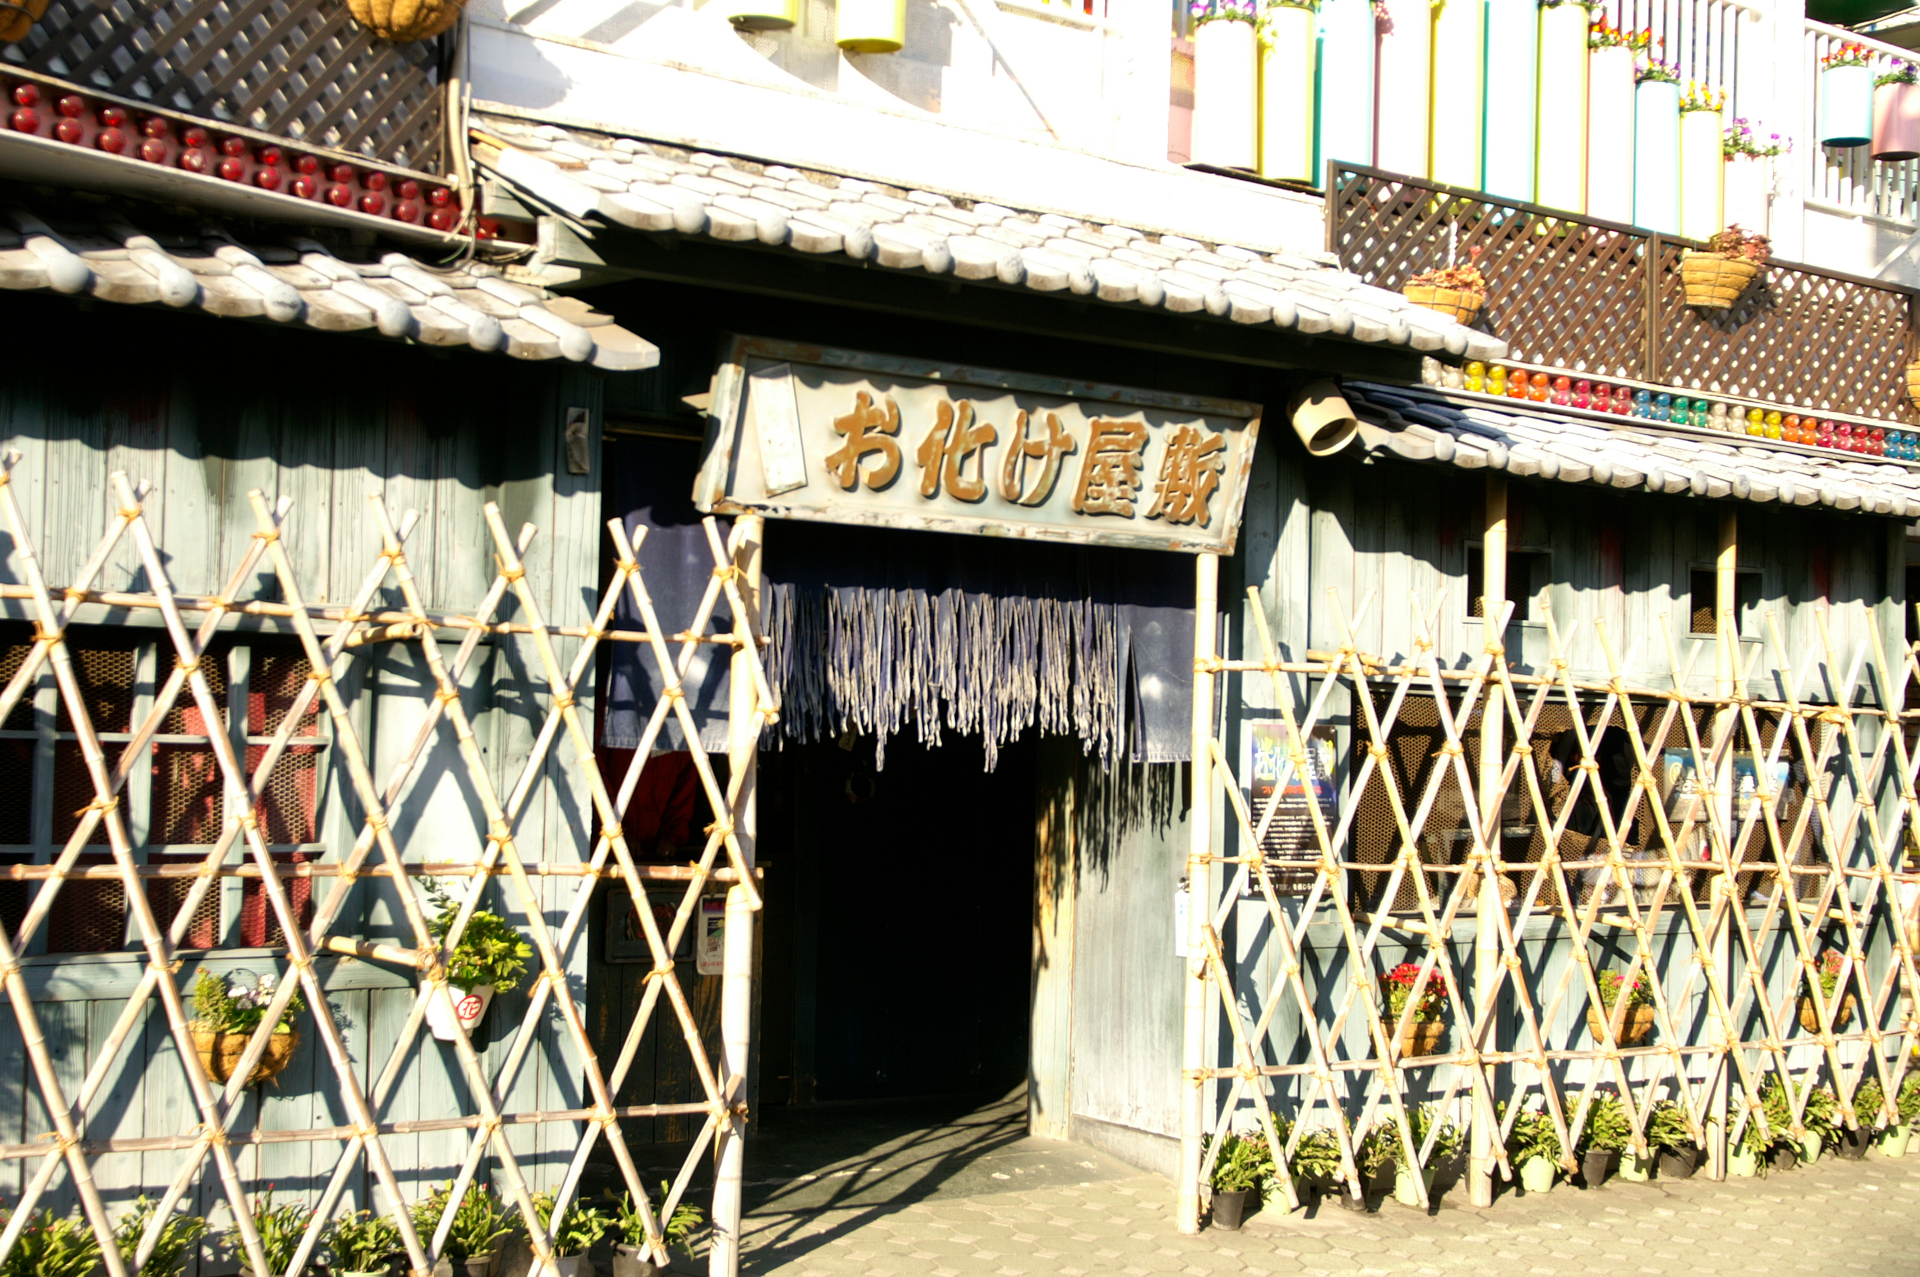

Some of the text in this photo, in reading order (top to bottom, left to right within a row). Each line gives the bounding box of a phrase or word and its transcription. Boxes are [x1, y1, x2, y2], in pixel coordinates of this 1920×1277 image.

[825, 391, 1226, 526] お化け屋敷
